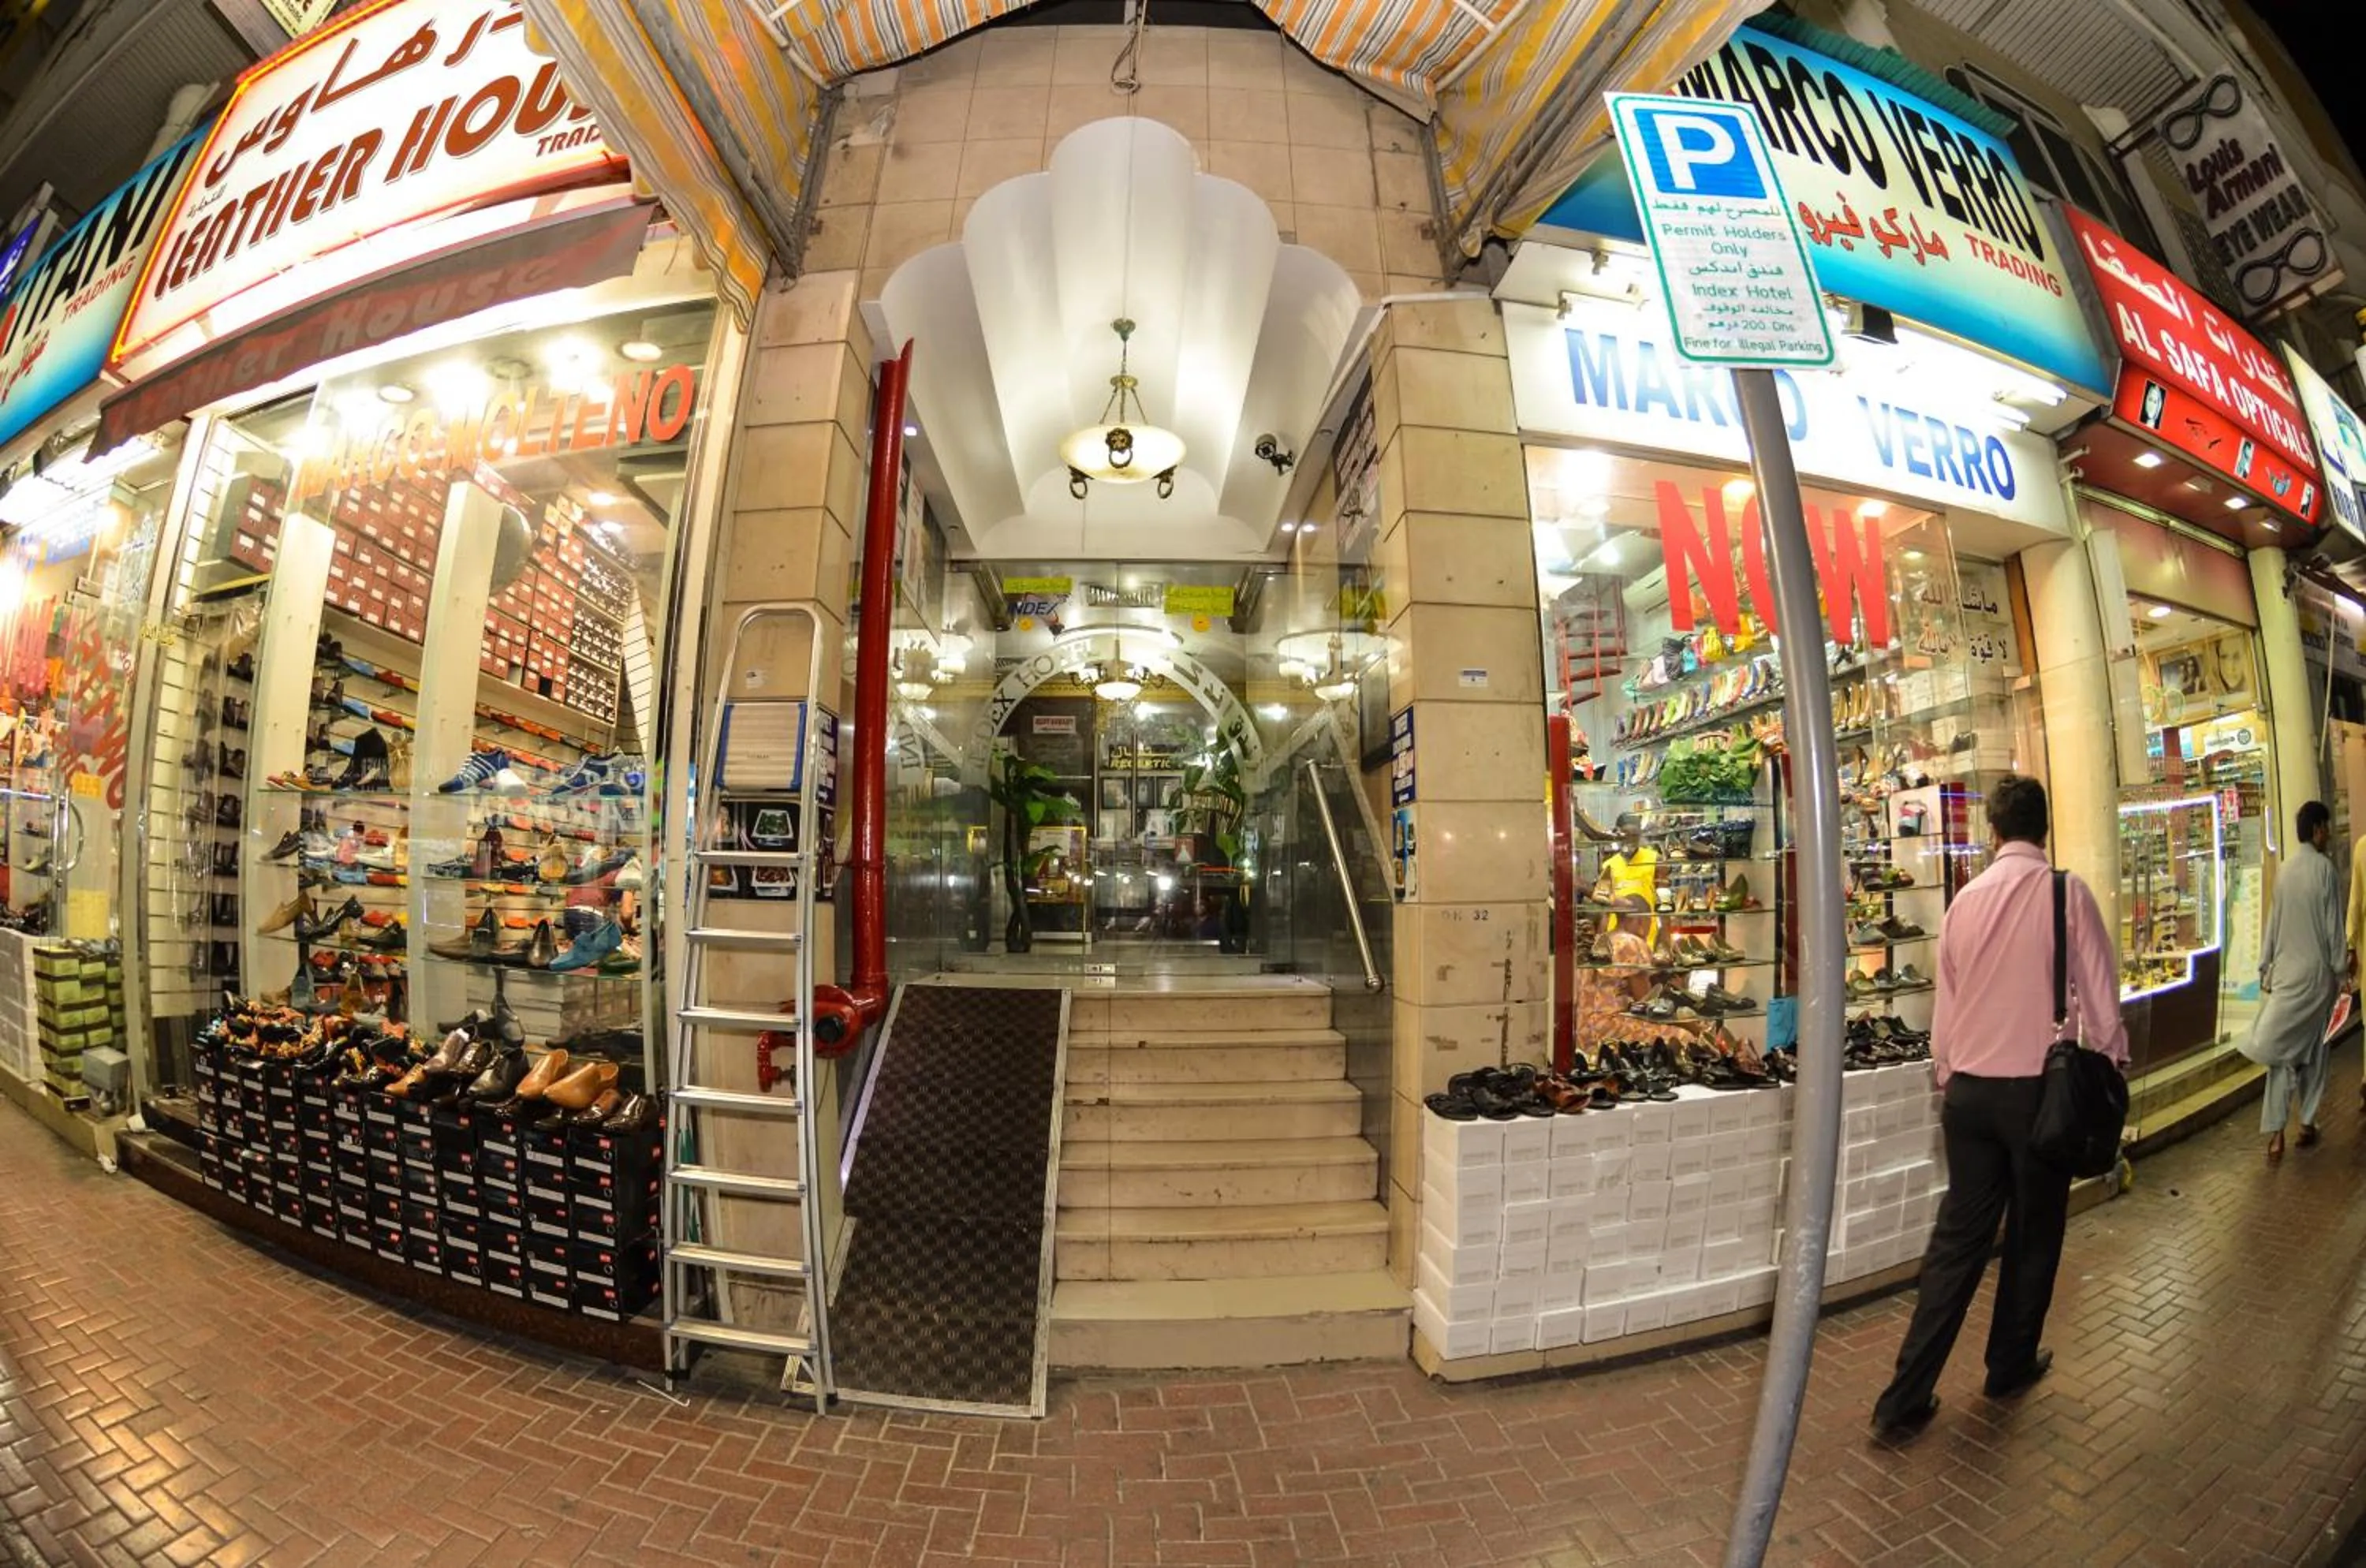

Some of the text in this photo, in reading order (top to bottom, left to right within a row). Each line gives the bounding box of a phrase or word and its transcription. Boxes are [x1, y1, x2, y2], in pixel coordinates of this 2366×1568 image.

[536, 124, 601, 158] TRAD
[1652, 113, 1736, 191] P
[2185, 138, 2245, 194] Louis
[155, 127, 384, 299] LEATHER
[383, 61, 593, 185] HOU
[1865, 88, 2045, 264] VERRO
[0, 138, 196, 360] ITANI
[1661, 223, 1787, 241] Permit Holders
[1711, 241, 1748, 257] Only
[1798, 190, 1950, 266] ماركو فيرو
[62, 256, 136, 323] TRADING
[1692, 283, 1793, 300] Index Hotel
[1965, 233, 2063, 298] TRADING
[1684, 337, 1825, 354] Fine for Illegal Parking
[1741, 319, 1767, 330] 200
[444, 363, 696, 471] MOLTENO
[1564, 327, 2017, 501] MARO VERRO
[2116, 302, 2161, 362] AL
[2160, 328, 2232, 407] SAFA
[2229, 376, 2316, 469] OPTICALS
[1473, 909, 1489, 920] 32
